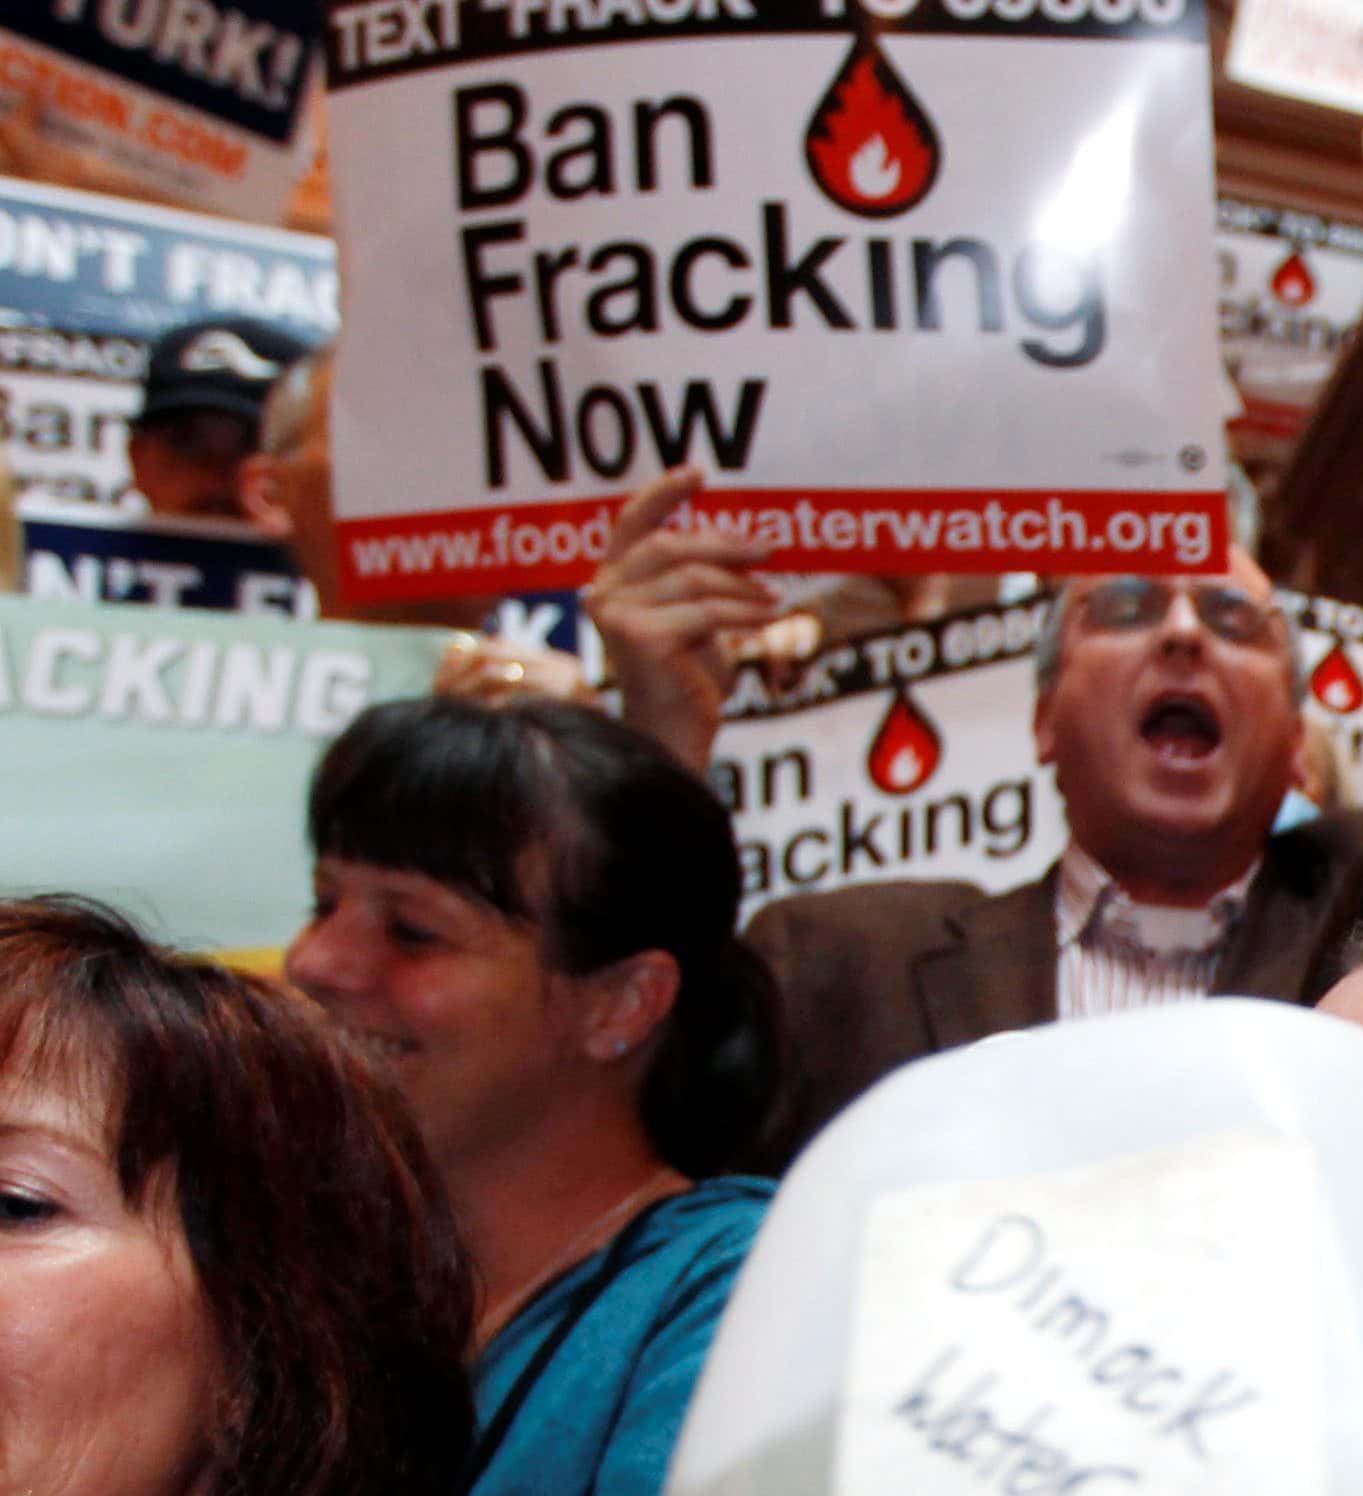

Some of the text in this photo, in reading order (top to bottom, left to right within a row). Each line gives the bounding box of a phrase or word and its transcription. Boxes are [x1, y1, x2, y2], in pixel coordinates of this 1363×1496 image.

[334, 0, 460, 71] TEXT
[453, 79, 715, 213] Ban
[459, 201, 1110, 369] Fracking
[479, 358, 768, 490] Now
[0, 626, 374, 738] CKING
[864, 629, 935, 684] TO
